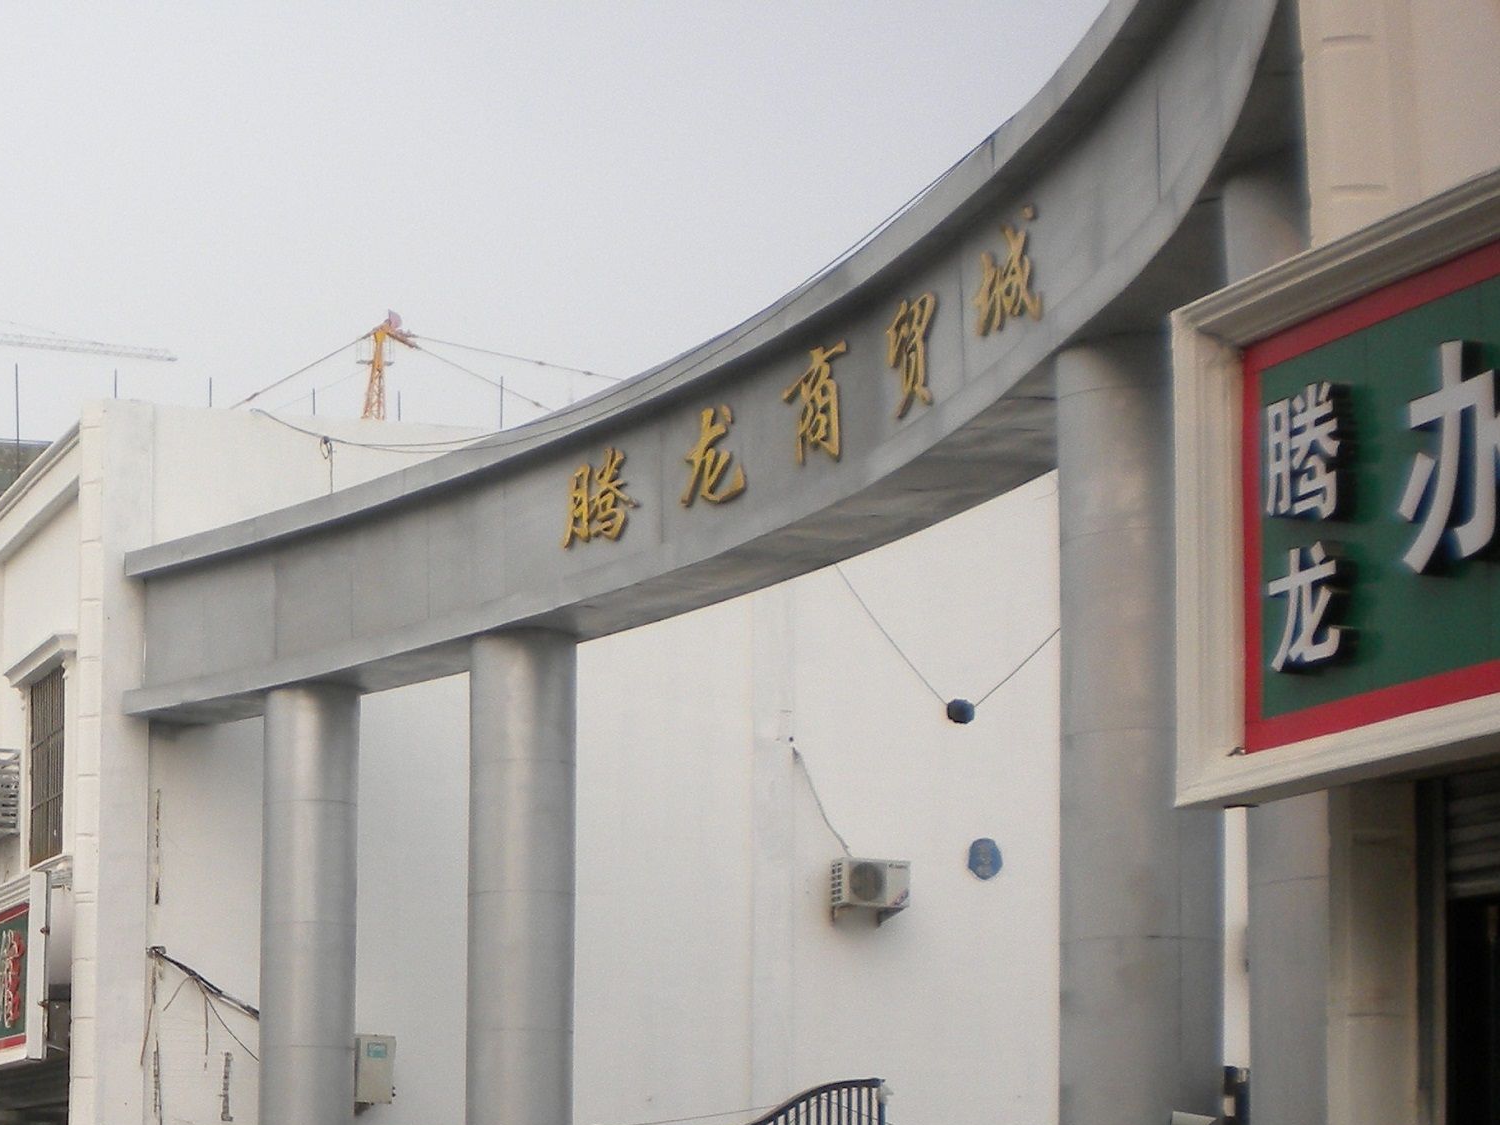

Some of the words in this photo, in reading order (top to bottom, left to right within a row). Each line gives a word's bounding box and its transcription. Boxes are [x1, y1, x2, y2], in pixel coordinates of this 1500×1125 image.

[563, 204, 1043, 551] 腾龙商贸城
[1266, 380, 1342, 673] 腾龙
